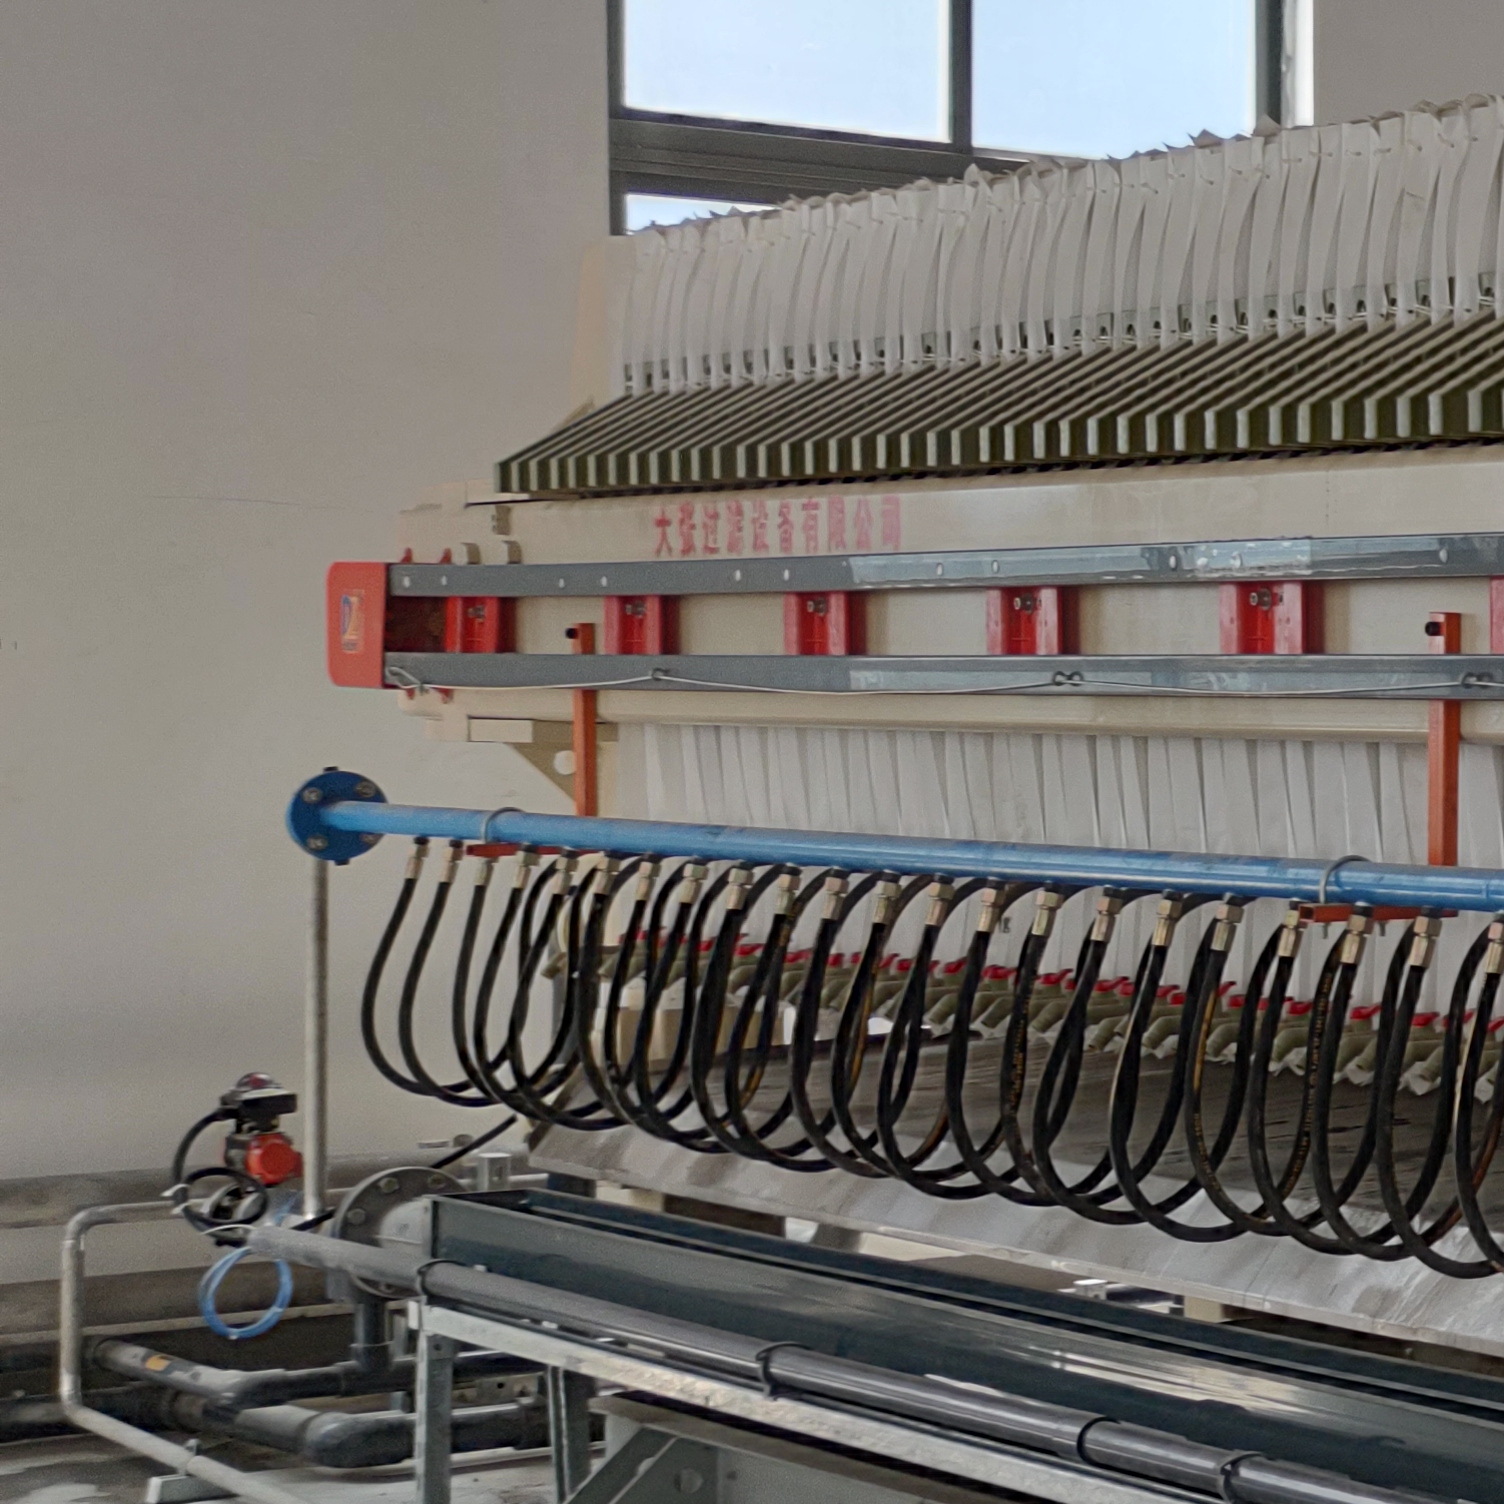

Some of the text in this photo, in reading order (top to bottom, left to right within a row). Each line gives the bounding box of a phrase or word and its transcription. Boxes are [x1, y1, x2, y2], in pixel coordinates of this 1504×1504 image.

[654, 495, 902, 557] 大张过滤设备有限公司
